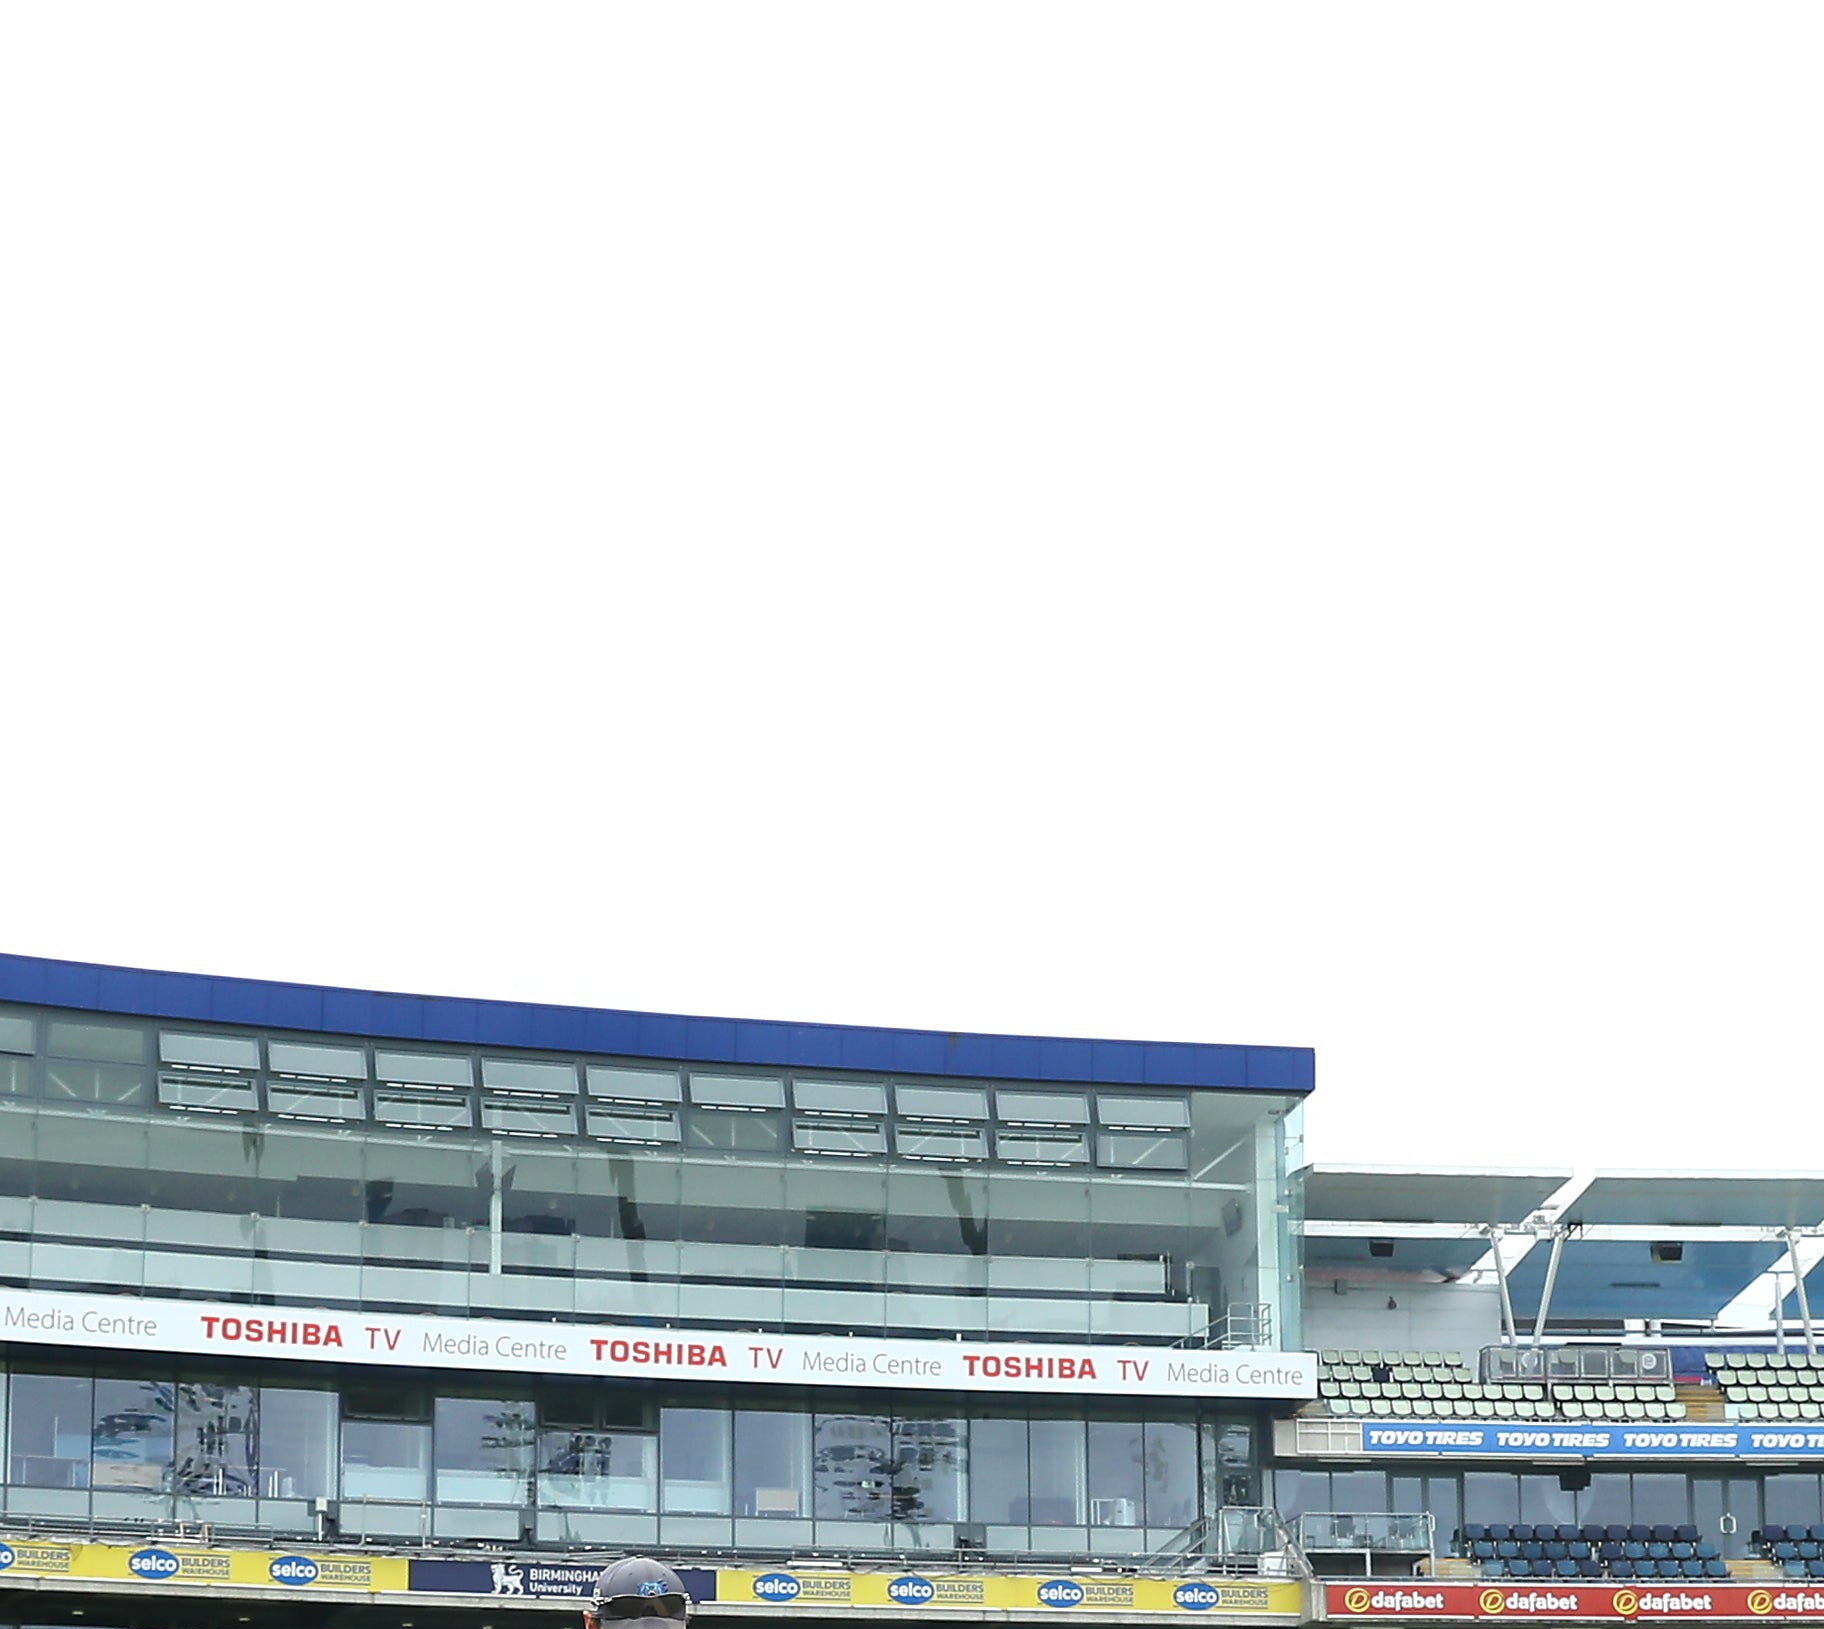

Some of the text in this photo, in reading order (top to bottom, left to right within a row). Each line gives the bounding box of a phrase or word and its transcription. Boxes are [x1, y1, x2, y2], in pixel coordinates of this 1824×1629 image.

[5, 1306, 74, 1331] Media
[82, 1311, 157, 1336] Centre
[201, 1316, 567, 1361] TOSHIBA TV Media Centre
[590, 1340, 942, 1377] TOSHIBA TV Media Centre
[963, 1355, 1303, 1387] TOSHIBA TV Media Centre
[1370, 1431, 1483, 1446] TOYO TIRES
[1496, 1432, 1610, 1447] TOYO TIRES
[1623, 1433, 1738, 1448] TOYO TIRES
[1751, 1434, 1806, 1448] TOYO
[17, 1548, 69, 1561] BUILDERS
[17, 1558, 69, 1569] WAREHOUSE
[131, 1556, 176, 1572] selco
[271, 1563, 316, 1579] selco
[320, 1564, 371, 1575] BUILDERS
[320, 1573, 370, 1584] WAREHOUSE
[529, 1568, 604, 1583] BIRMINGHA
[529, 1582, 583, 1596] University
[756, 1580, 799, 1595] selco
[802, 1580, 851, 1590] BUILDERS
[890, 1584, 933, 1599] selco
[936, 1584, 984, 1594] BUILDERS
[1086, 1586, 1134, 1596] BUILDERS
[802, 1589, 851, 1600] WAREHOUSE
[1040, 1587, 1082, 1601] selco
[1175, 1590, 1217, 1604] selco
[1220, 1589, 1268, 1598] BUILDERS
[1371, 1591, 1444, 1611] dafabet
[1506, 1592, 1577, 1612] dafabet
[1639, 1592, 1712, 1612] dafabet
